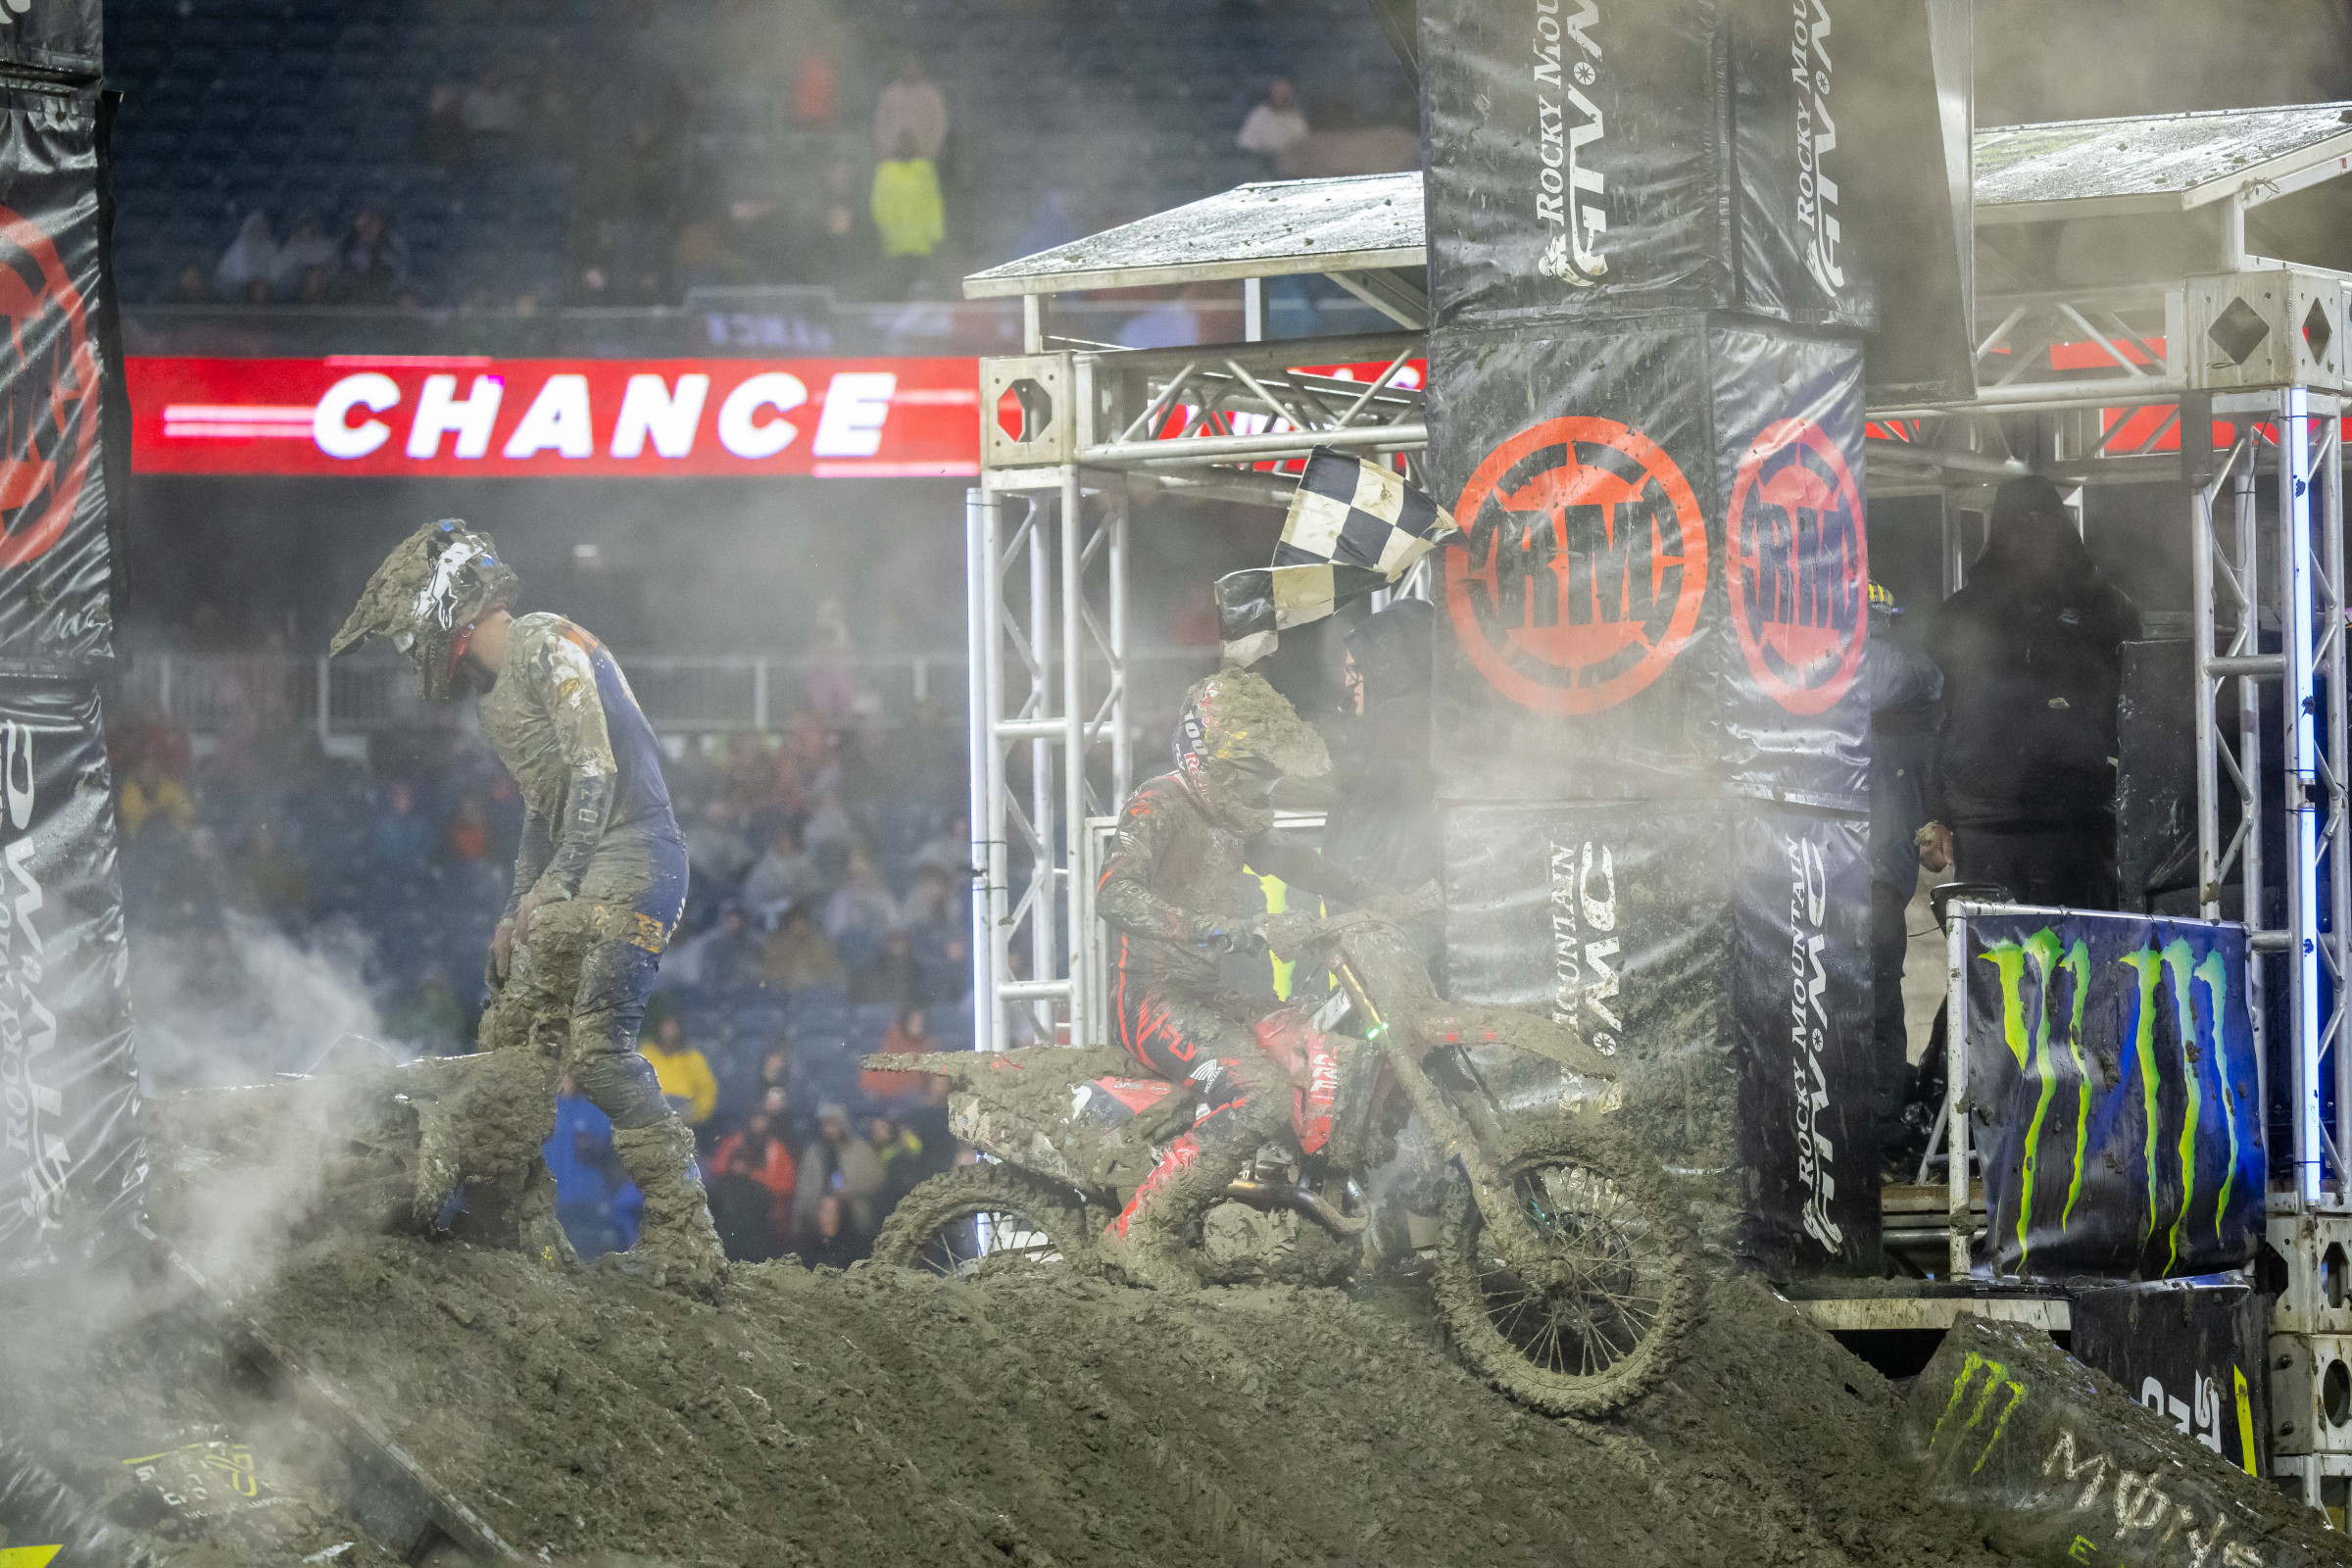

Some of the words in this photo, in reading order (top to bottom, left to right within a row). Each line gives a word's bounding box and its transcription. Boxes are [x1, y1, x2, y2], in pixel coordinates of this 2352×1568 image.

[1537, 94, 1565, 226] ROCKY
[1797, 96, 1816, 231] ROCKY
[313, 372, 896, 459] CHANCE
[1786, 834, 1808, 1054] MOUNTAIN
[1203, 1066, 1224, 1095] HONDA
[1792, 1054, 1813, 1190] ROCKY
